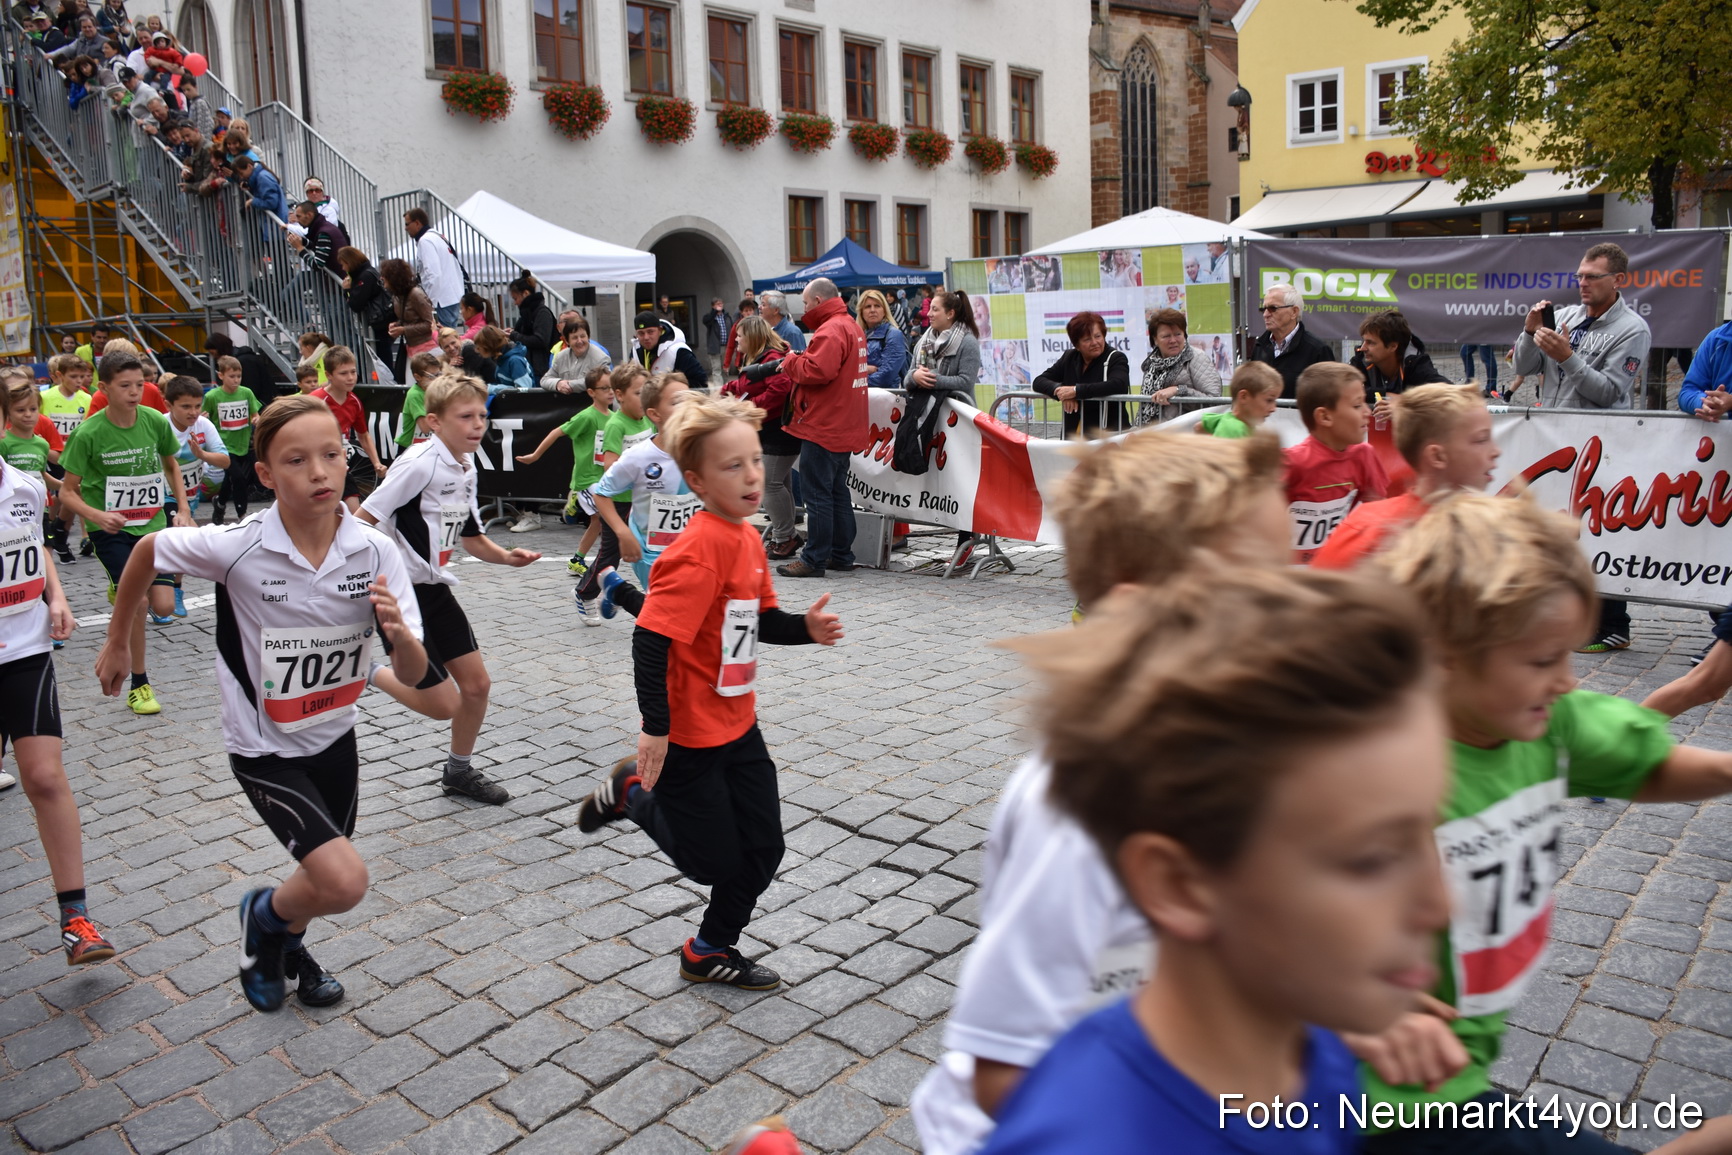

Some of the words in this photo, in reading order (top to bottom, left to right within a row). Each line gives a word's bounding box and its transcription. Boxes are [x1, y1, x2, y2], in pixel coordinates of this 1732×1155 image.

[1365, 151, 1412, 175] Der
[1262, 271, 1392, 298] BOCK
[1407, 273, 1478, 290] OFFICE
[1317, 303, 1348, 313] smart
[1042, 338, 1074, 352] Neu
[221, 407, 247, 420] 7432
[101, 447, 143, 459] Neumarkter
[102, 456, 137, 465] Stadtlauf
[130, 479, 154, 487] Neumarkt
[113, 486, 159, 508] 7129
[846, 470, 911, 508] tbayerns
[918, 490, 959, 515] Radio
[346, 571, 371, 581] SPORT
[261, 592, 288, 602] Lauri
[265, 639, 308, 650] PARTL
[310, 632, 362, 649] Neumarkt
[276, 644, 363, 694] 7021
[302, 693, 335, 715] Lauri
